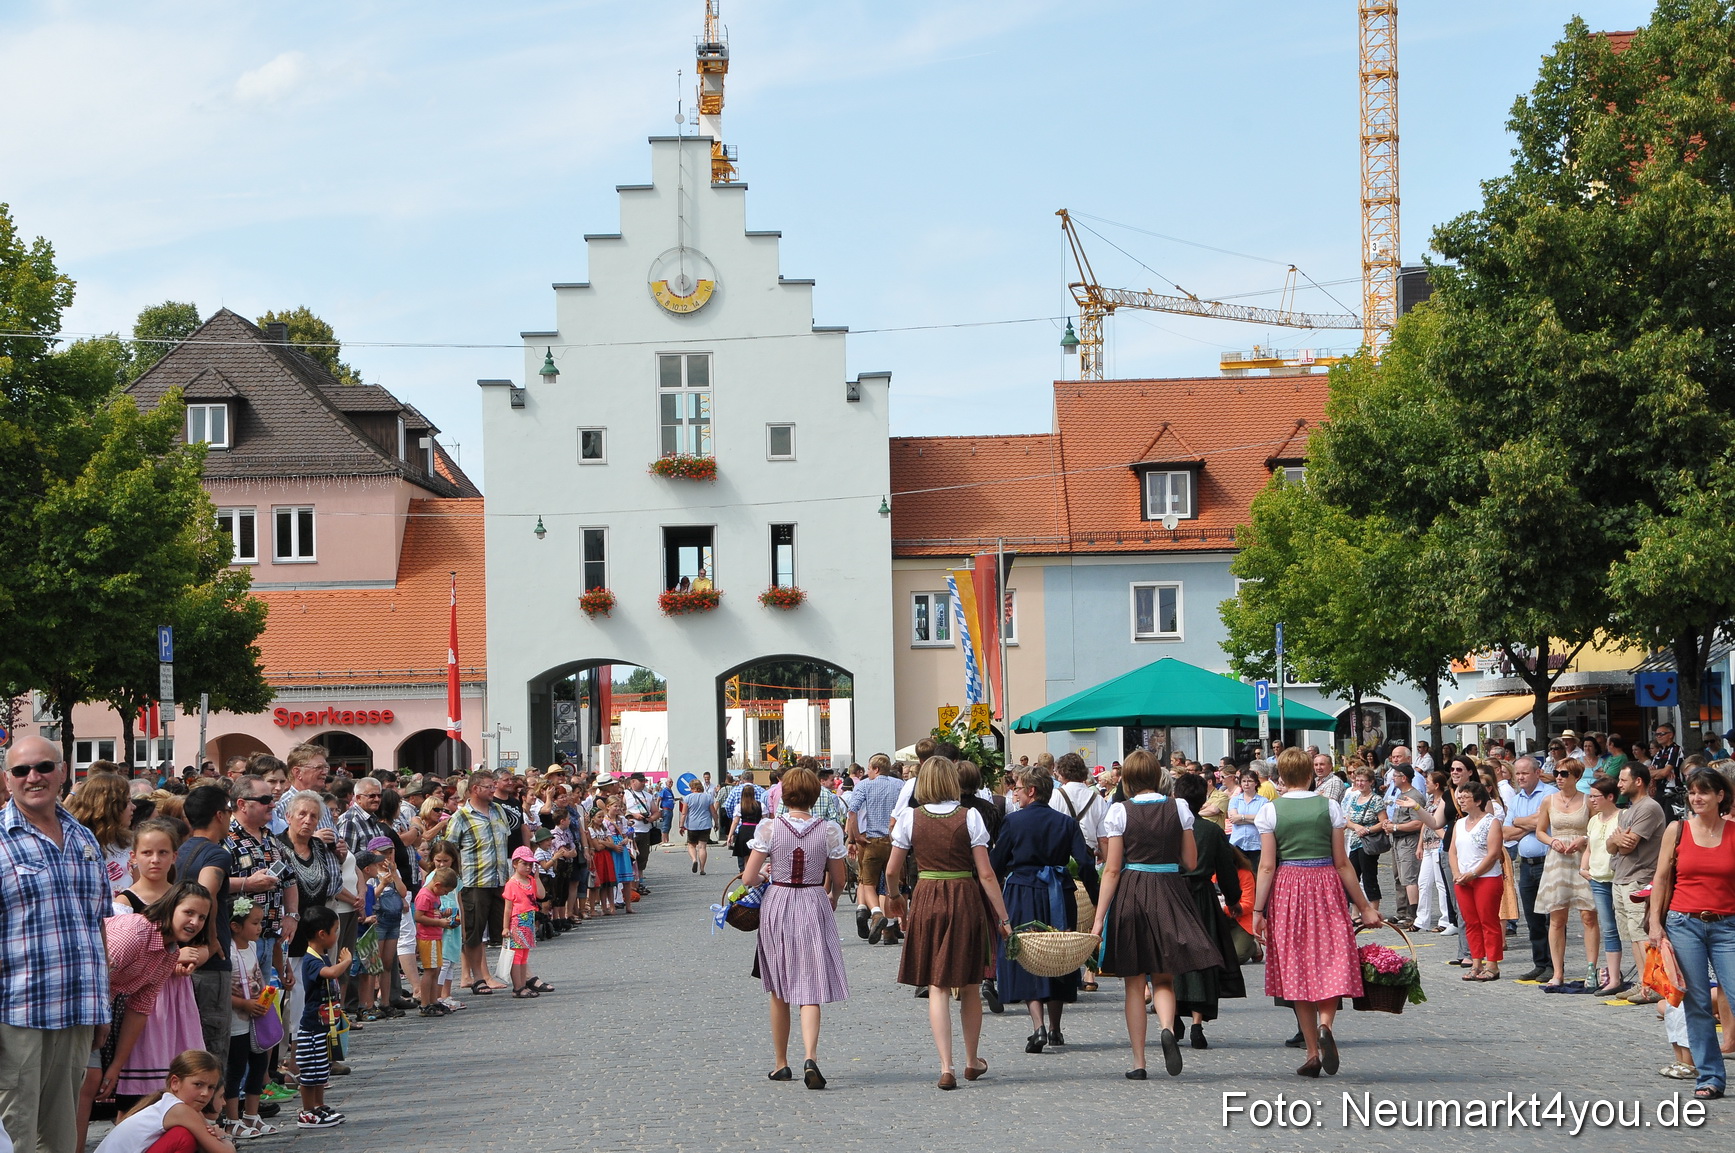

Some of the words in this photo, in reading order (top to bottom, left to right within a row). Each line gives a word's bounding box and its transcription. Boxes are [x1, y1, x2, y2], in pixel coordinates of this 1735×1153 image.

[1372, 243, 1377, 251] 3
[161, 630, 170, 657] P
[1257, 684, 1266, 708] P
[273, 706, 395, 731] Sparkasse
